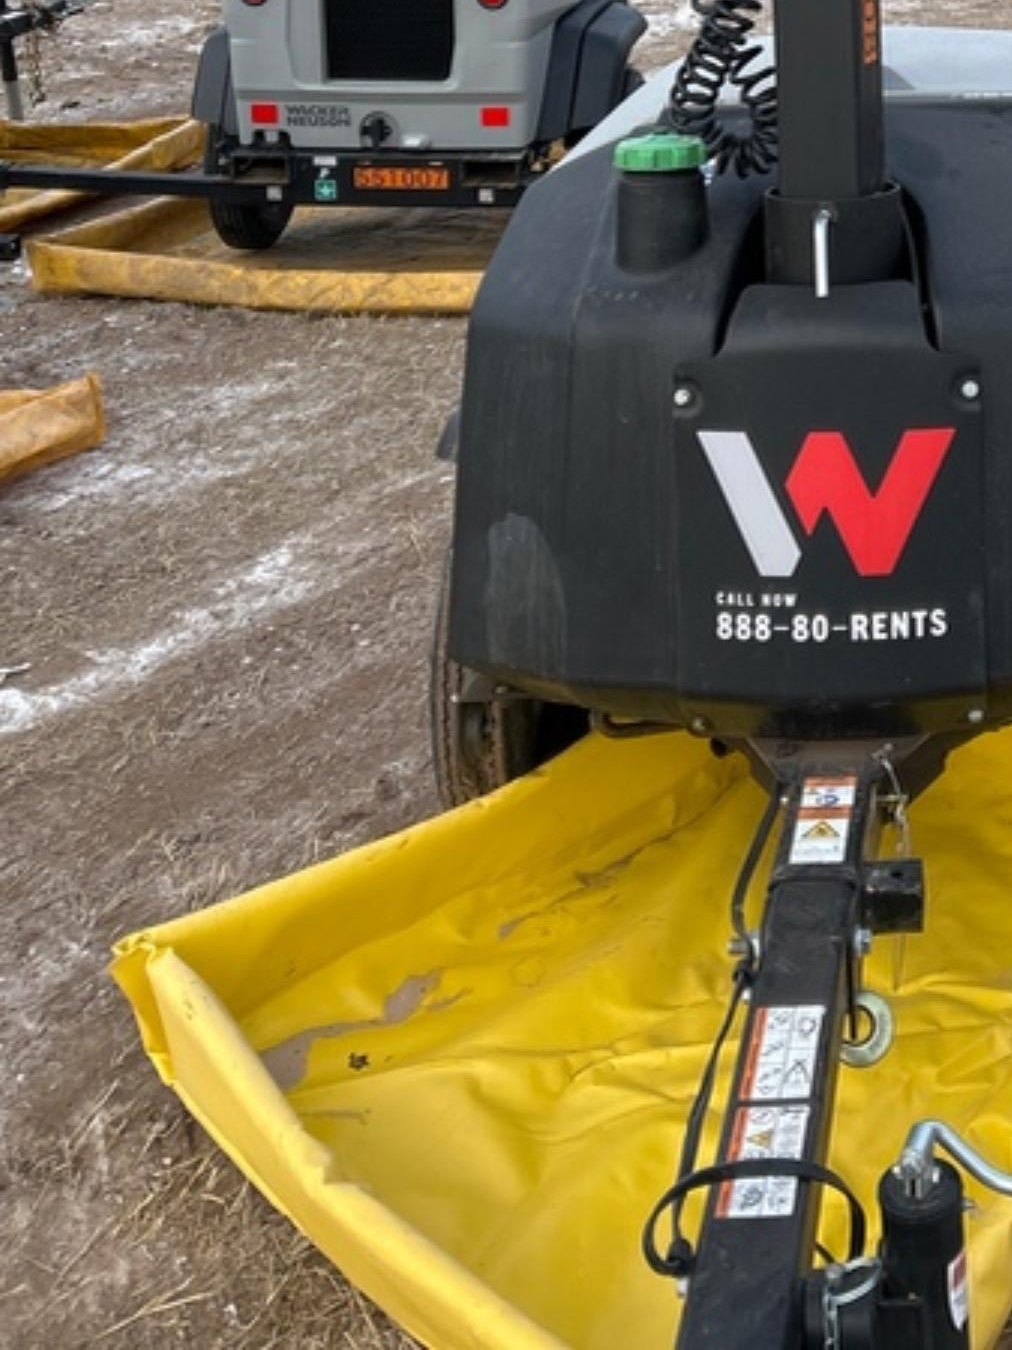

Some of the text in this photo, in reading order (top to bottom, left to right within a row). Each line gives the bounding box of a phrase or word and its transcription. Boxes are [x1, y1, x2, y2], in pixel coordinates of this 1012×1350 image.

[285, 105, 349, 115] WACKER
[287, 116, 351, 126] NEUSON
[716, 592, 797, 607] CALL NOW
[716, 608, 948, 642] 888-80-RENTS
